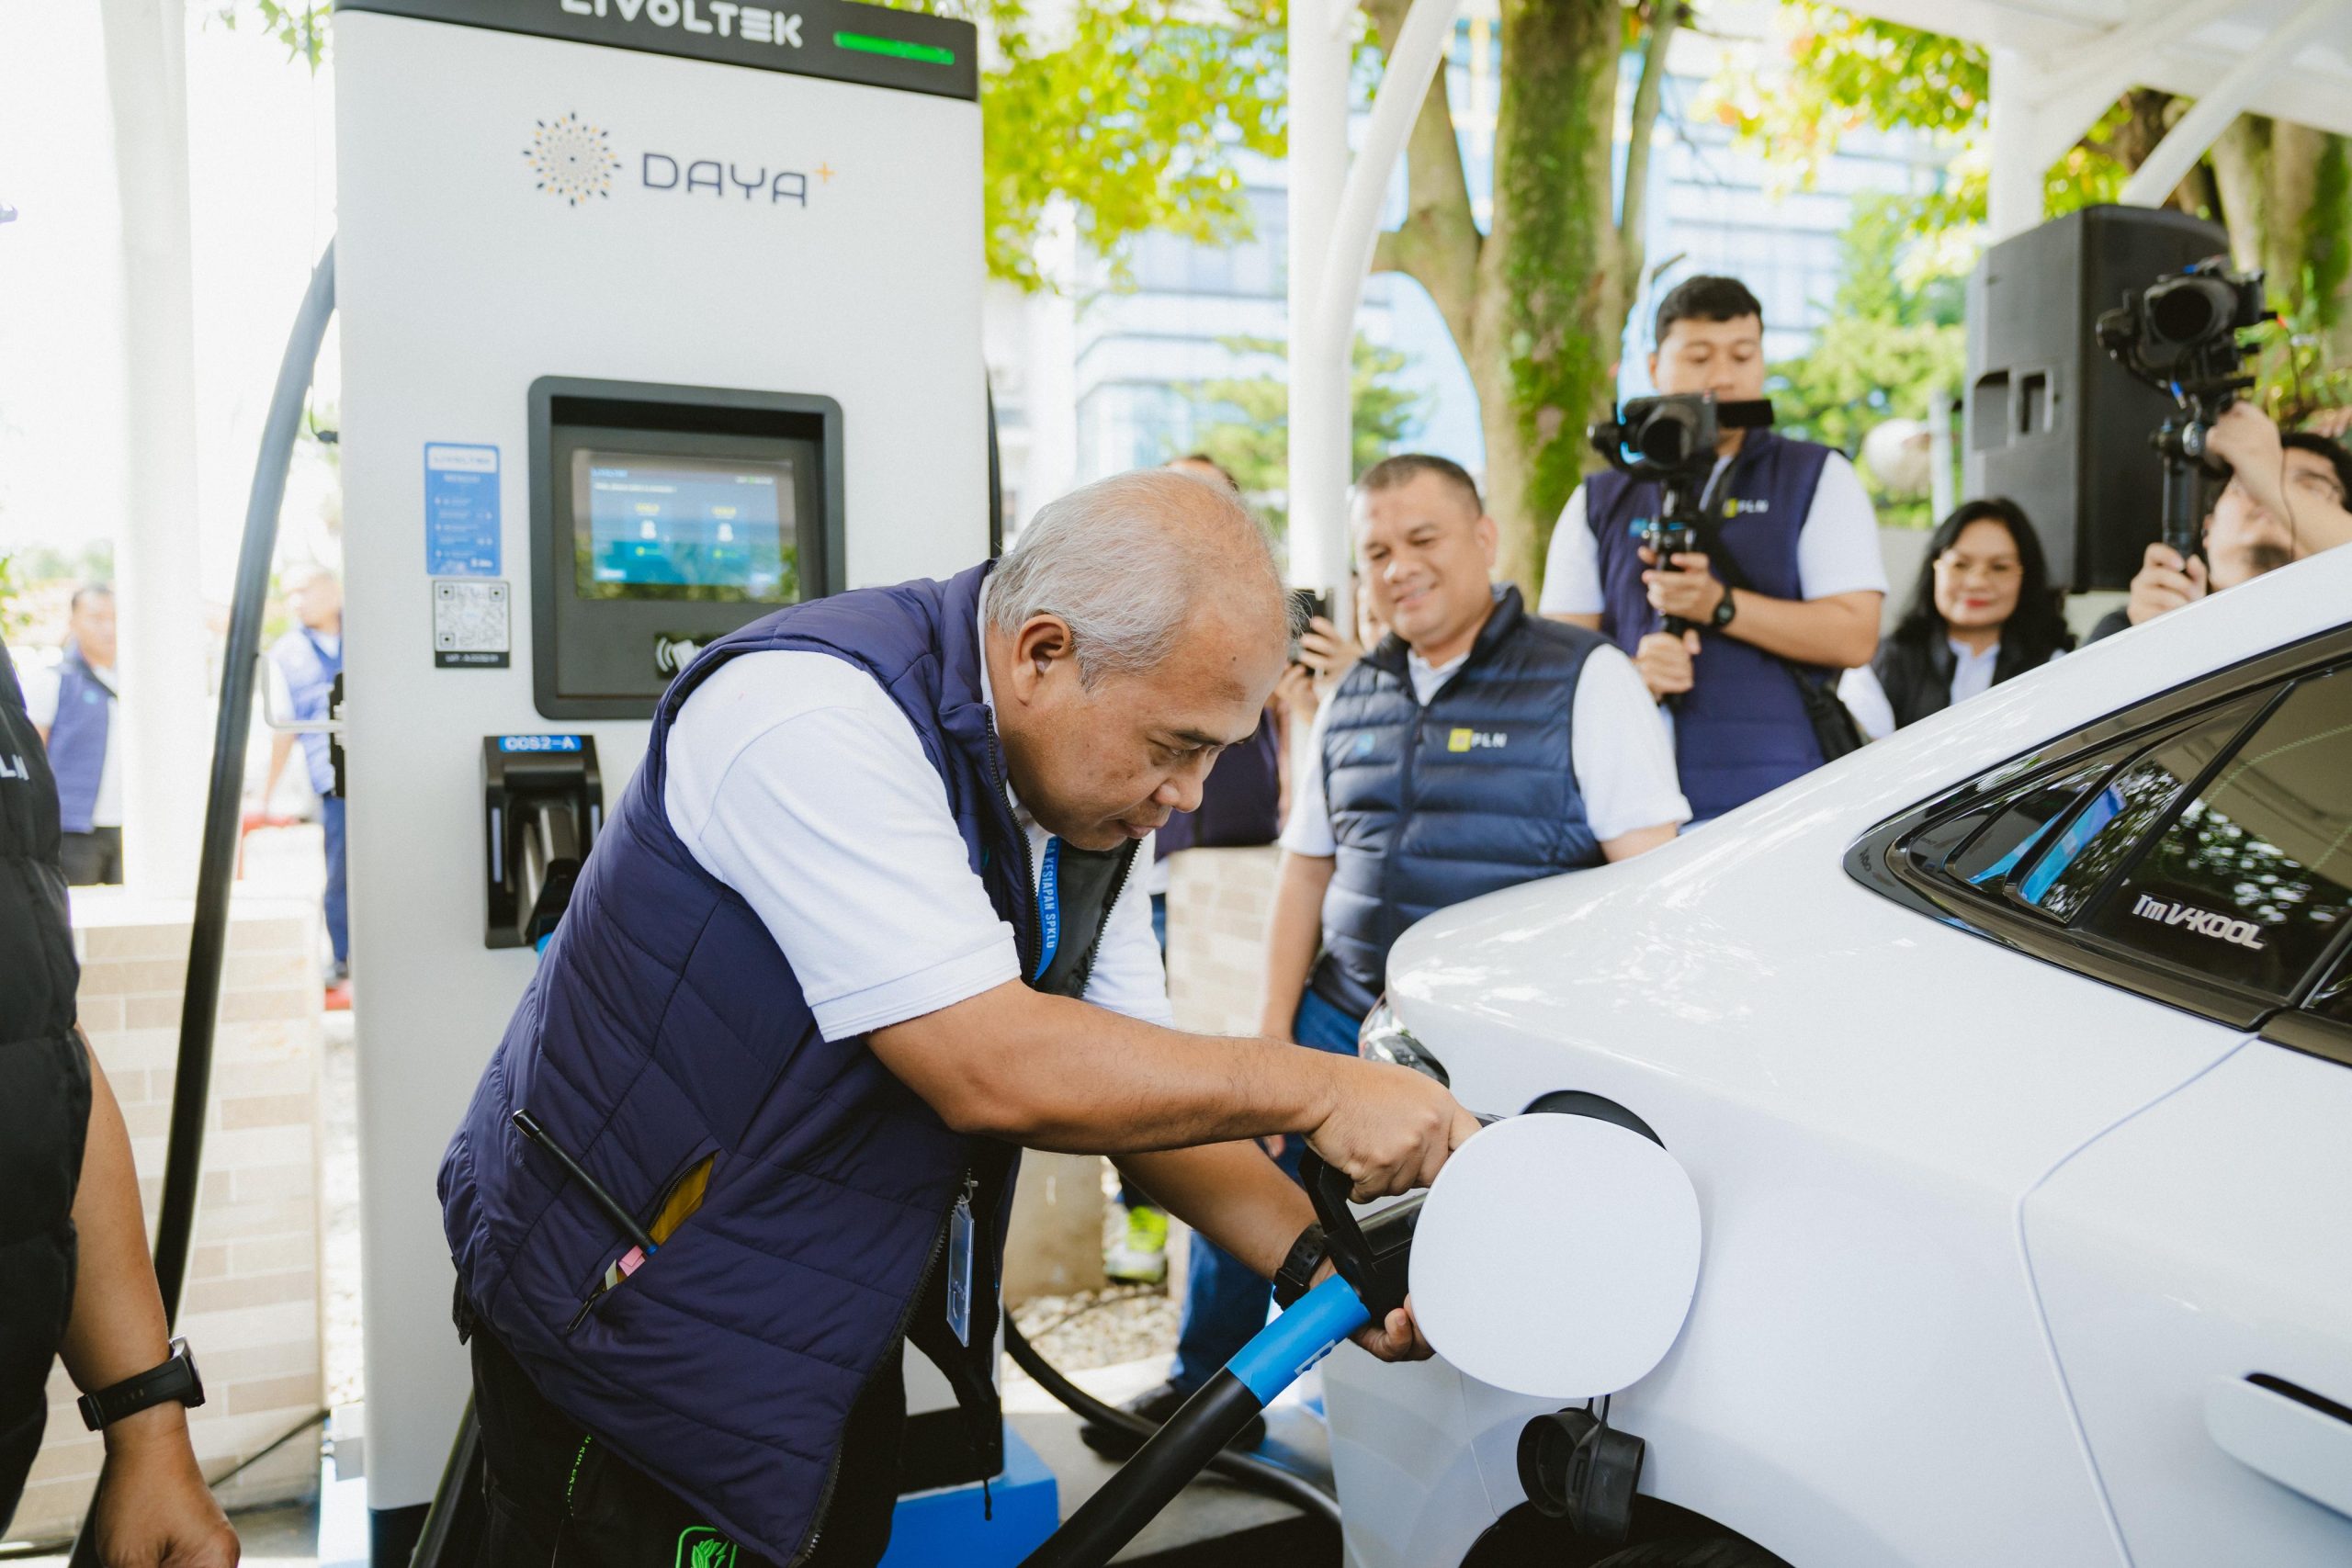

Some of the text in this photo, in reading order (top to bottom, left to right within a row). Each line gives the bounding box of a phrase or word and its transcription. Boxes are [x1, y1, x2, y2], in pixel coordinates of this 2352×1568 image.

[1471, 732, 1508, 749] PLN
[0, 754, 30, 781] LN
[1042, 856, 1056, 910] KESIAPAN
[1045, 914, 1057, 949] SPKLU
[2132, 894, 2265, 950] I'm V-KOOL
